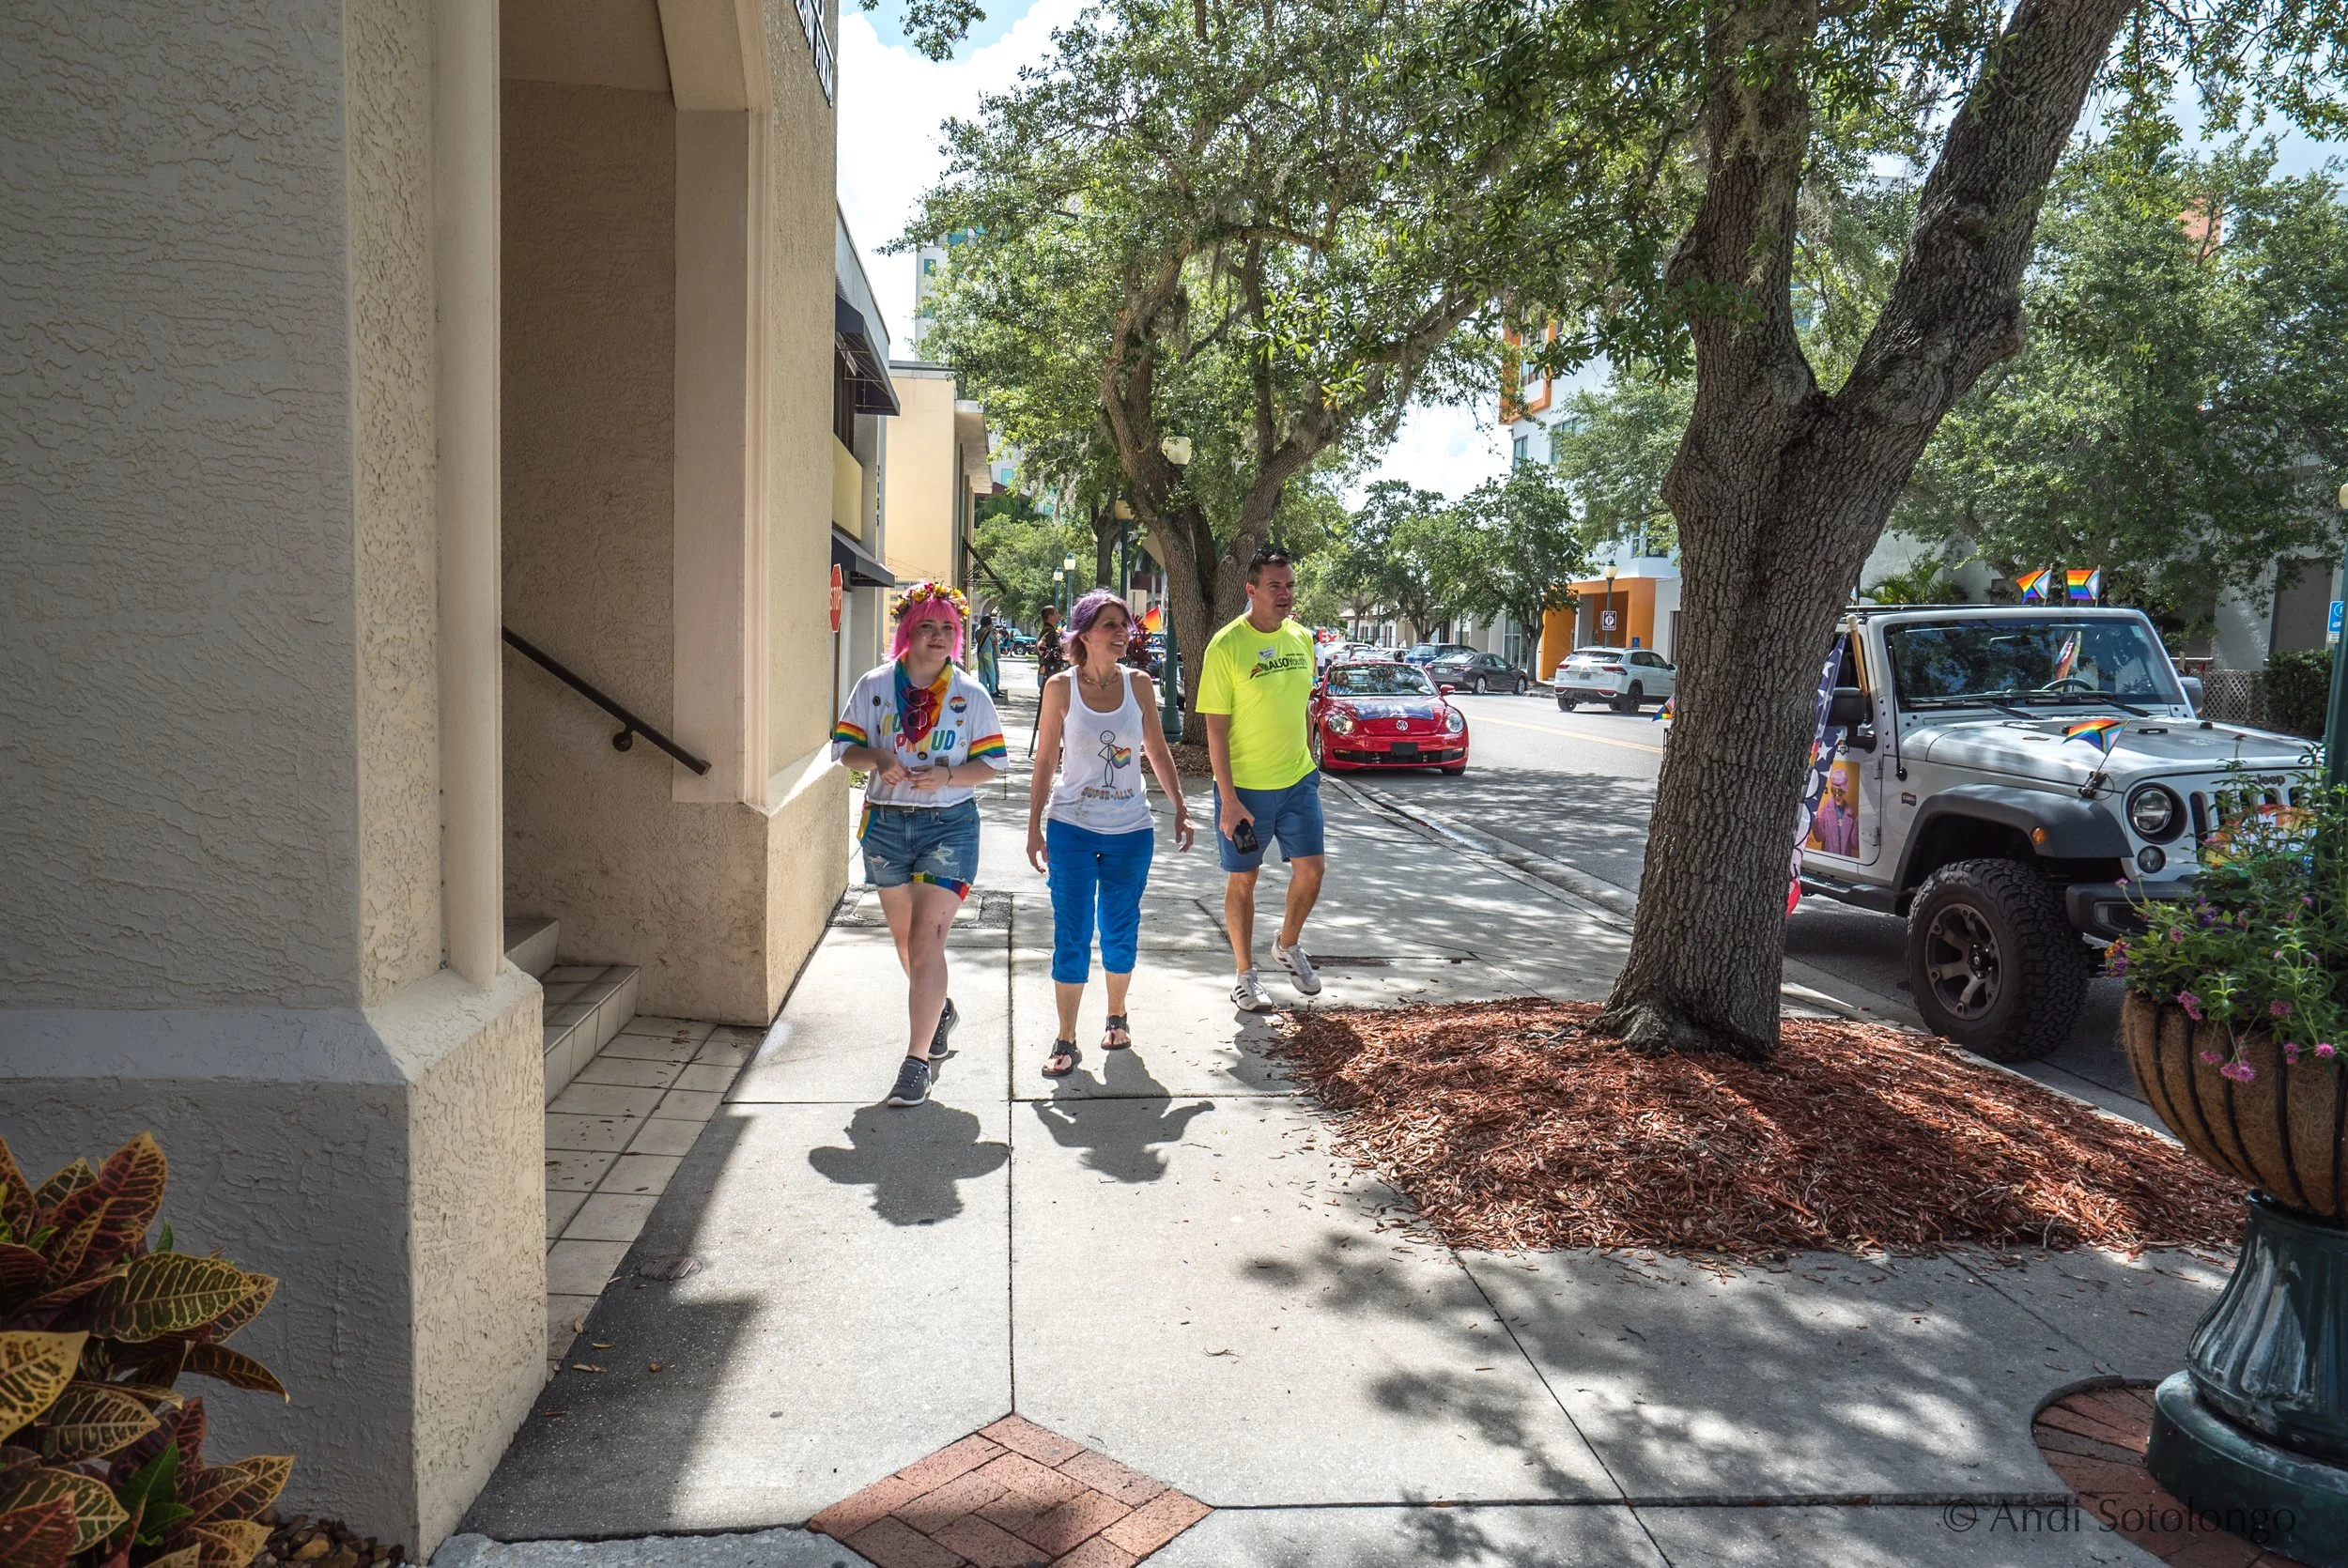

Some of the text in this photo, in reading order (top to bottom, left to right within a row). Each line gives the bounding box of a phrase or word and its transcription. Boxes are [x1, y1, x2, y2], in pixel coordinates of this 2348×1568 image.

[814, 23, 833, 108] FIRM
[830, 586, 842, 610] STOP
[2257, 774, 2286, 787] Jeep
